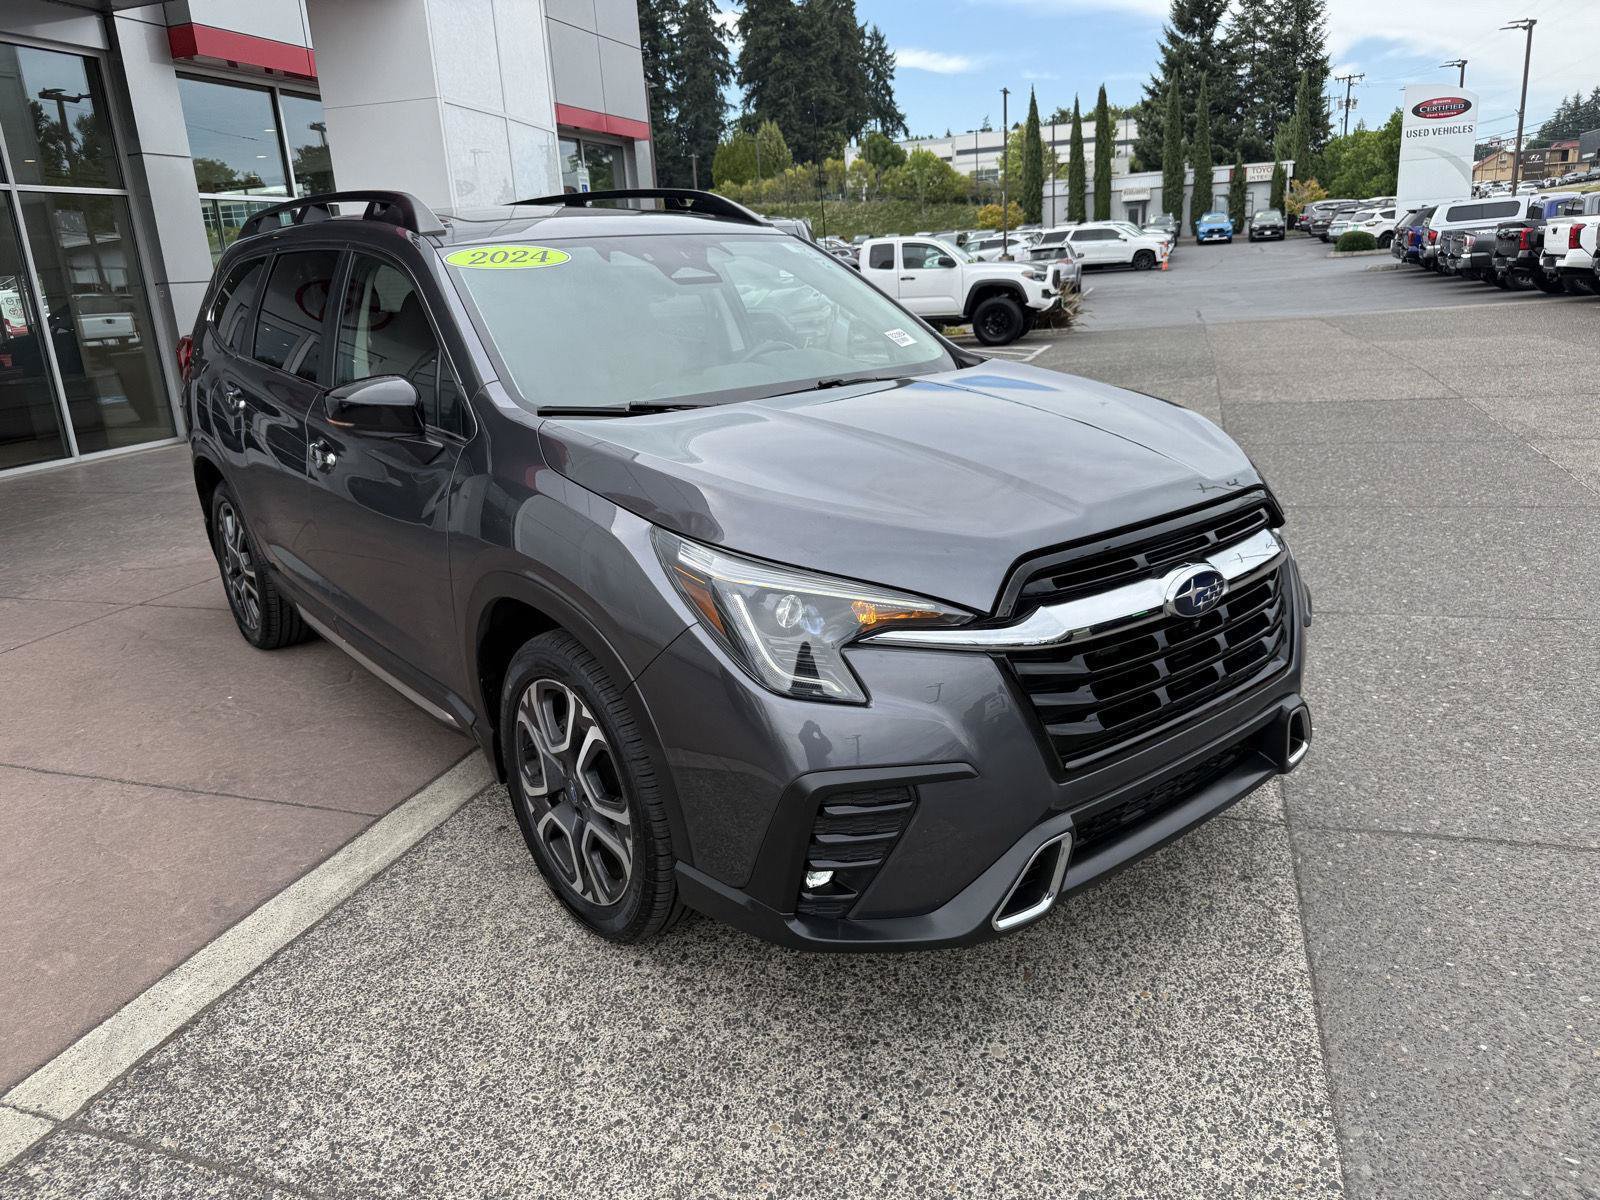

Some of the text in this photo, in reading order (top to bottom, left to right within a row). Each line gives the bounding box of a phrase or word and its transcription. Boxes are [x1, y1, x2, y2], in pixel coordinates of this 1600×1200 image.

[1406, 124, 1474, 138] USED VEHICLES
[468, 250, 551, 265] 2024
